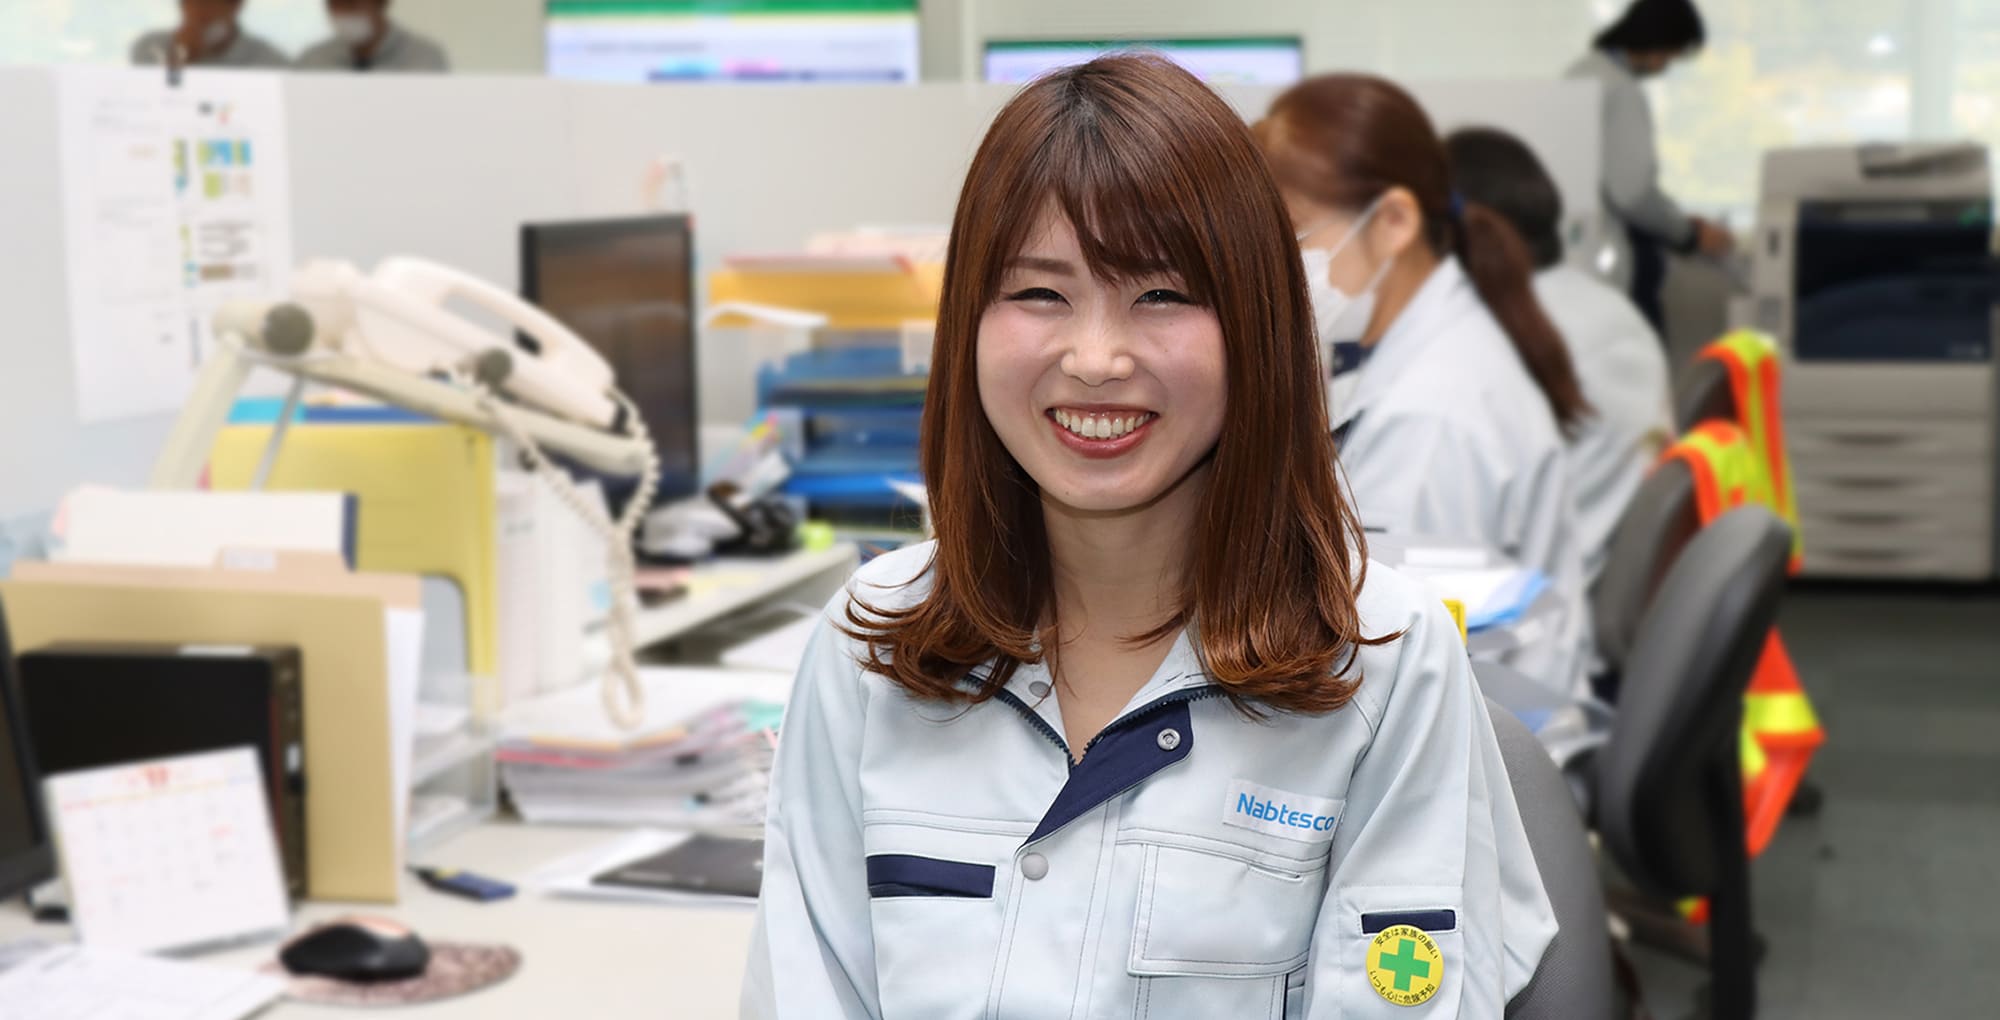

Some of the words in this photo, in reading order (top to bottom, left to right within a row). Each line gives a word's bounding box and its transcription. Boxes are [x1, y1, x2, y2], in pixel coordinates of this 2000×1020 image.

[1237, 792, 1335, 831] Nabtesco
[1374, 927, 1438, 959] 安全は家族の願い
